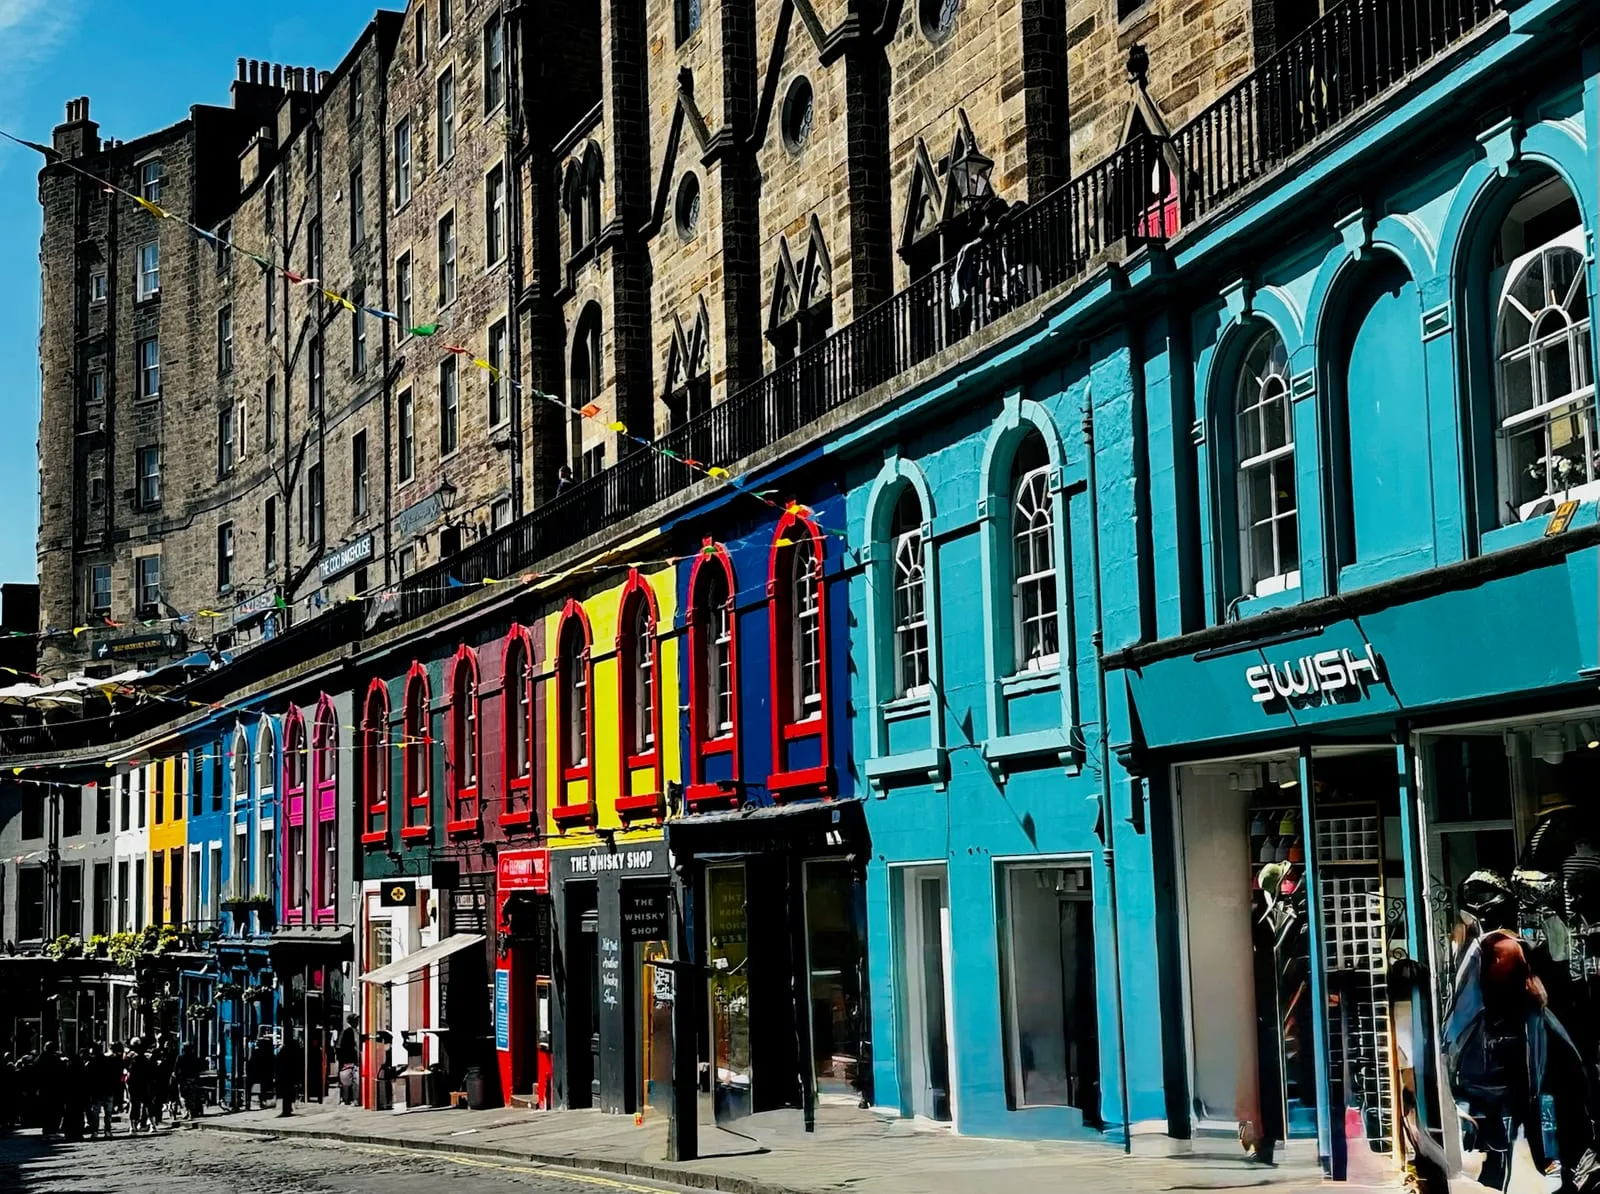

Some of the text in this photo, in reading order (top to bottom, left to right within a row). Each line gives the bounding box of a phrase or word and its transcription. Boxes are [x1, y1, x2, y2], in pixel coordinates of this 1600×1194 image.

[320, 562, 330, 577] THE
[341, 538, 371, 567] BAKEHOUSE
[1246, 643, 1379, 703] SWISH
[570, 850, 653, 873] THE WHISKY SHOP
[634, 898, 654, 907] THE
[624, 912, 665, 922] WHISKY
[631, 926, 659, 936] SHOP
